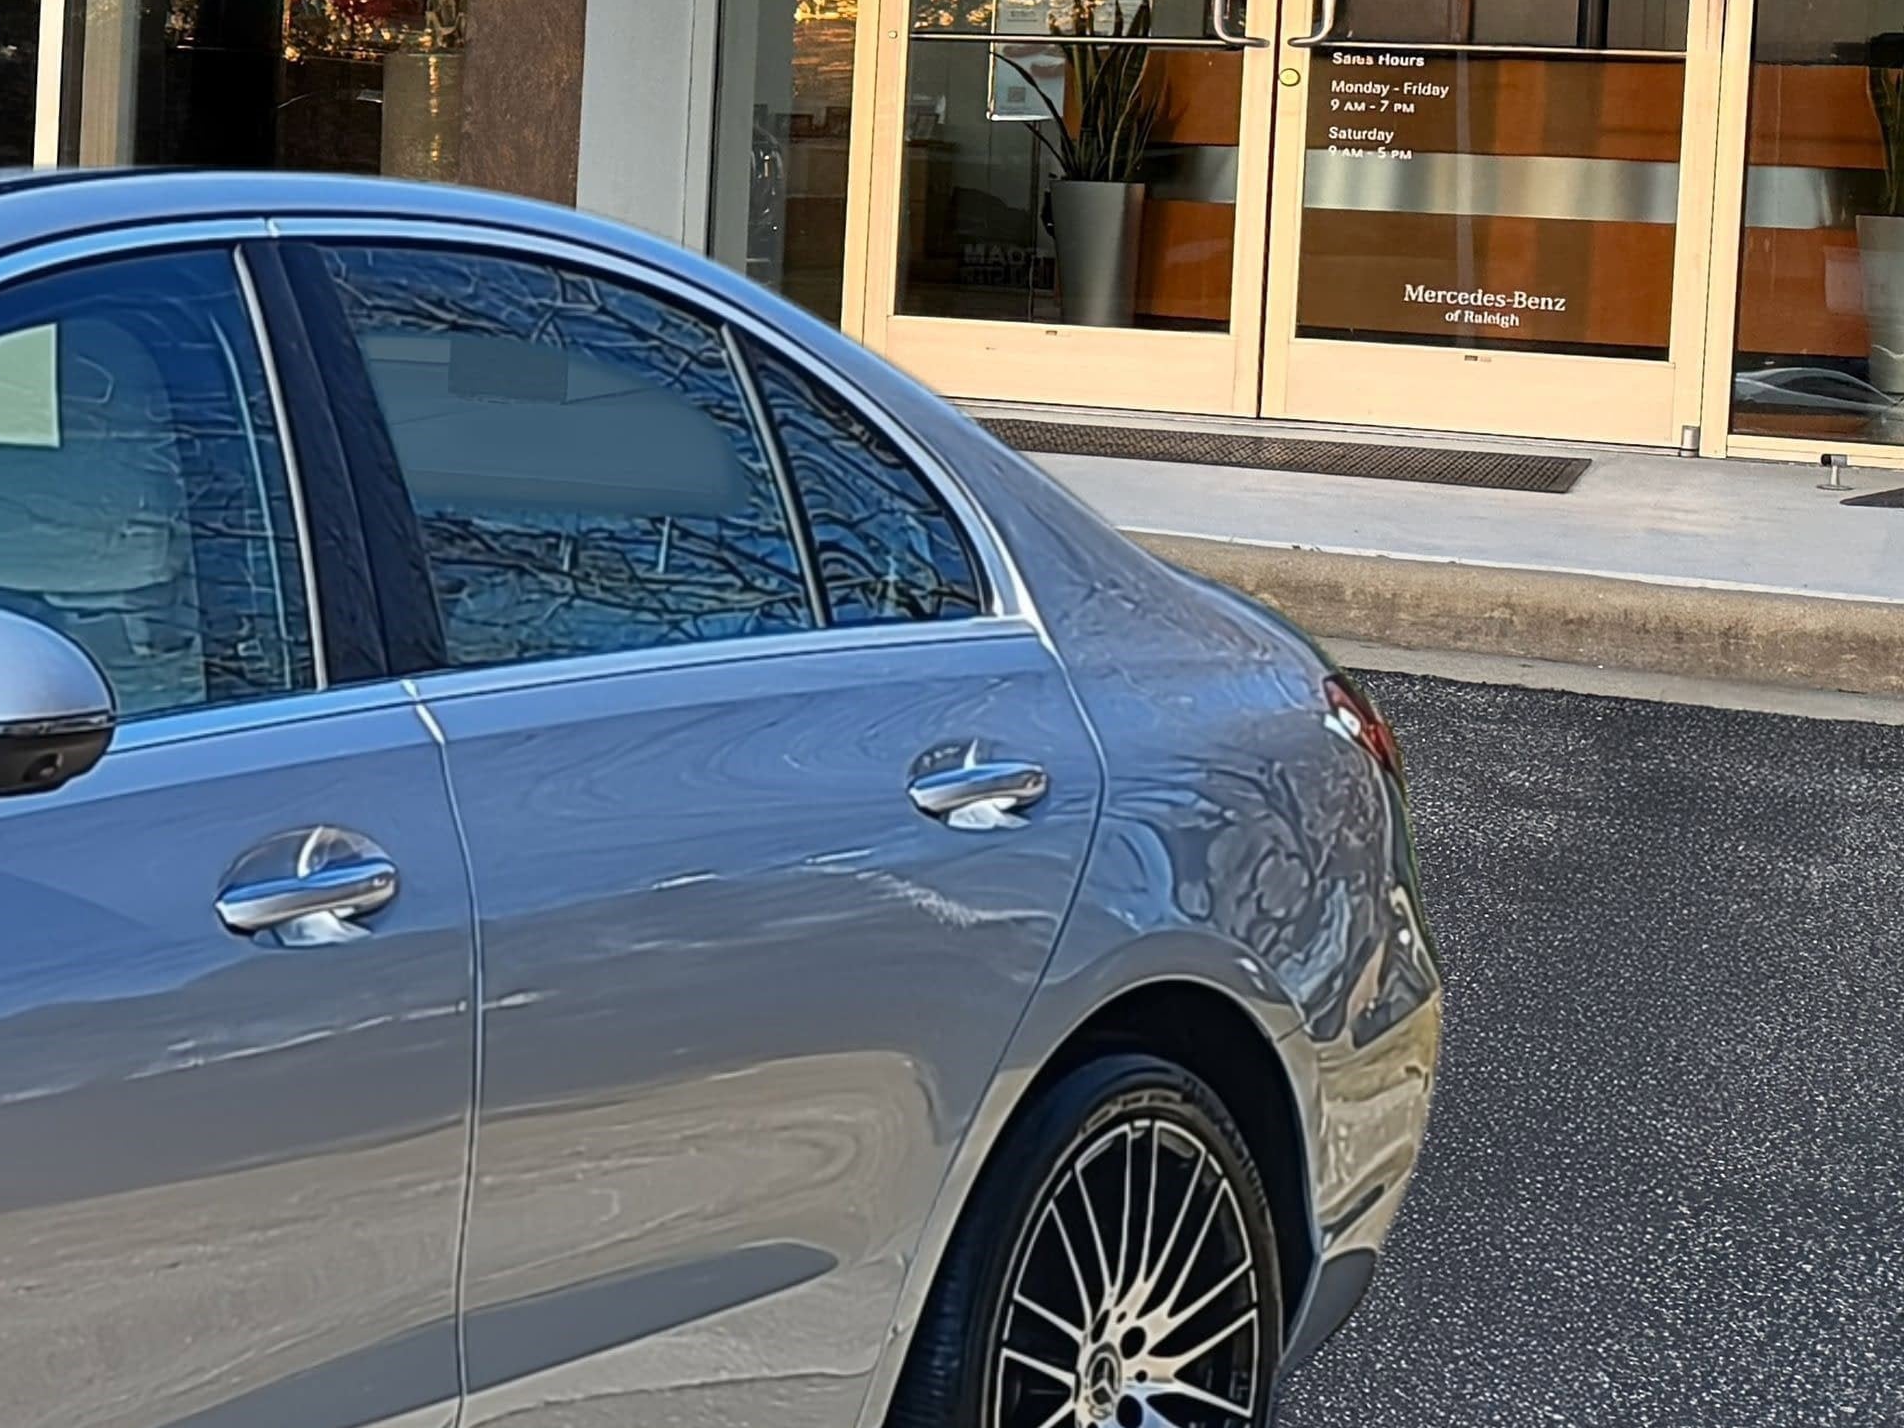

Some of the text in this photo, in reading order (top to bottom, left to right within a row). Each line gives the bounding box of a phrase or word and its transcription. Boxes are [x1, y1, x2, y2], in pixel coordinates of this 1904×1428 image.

[1378, 53, 1425, 67] Hours
[1331, 80, 1390, 97] Monday
[1403, 81, 1449, 98] Friday
[1330, 98, 1340, 111] 9
[1344, 101, 1366, 111] AM
[1380, 99, 1389, 112] 7
[1393, 103, 1415, 113] PM
[1328, 126, 1394, 144] Saturday
[1328, 145, 1337, 157] 9
[1342, 147, 1364, 158] AM
[1377, 146, 1387, 159] 5
[1391, 149, 1412, 159] PM
[1403, 284, 1566, 312] Mercedes-Benz
[1445, 310, 1462, 322] of
